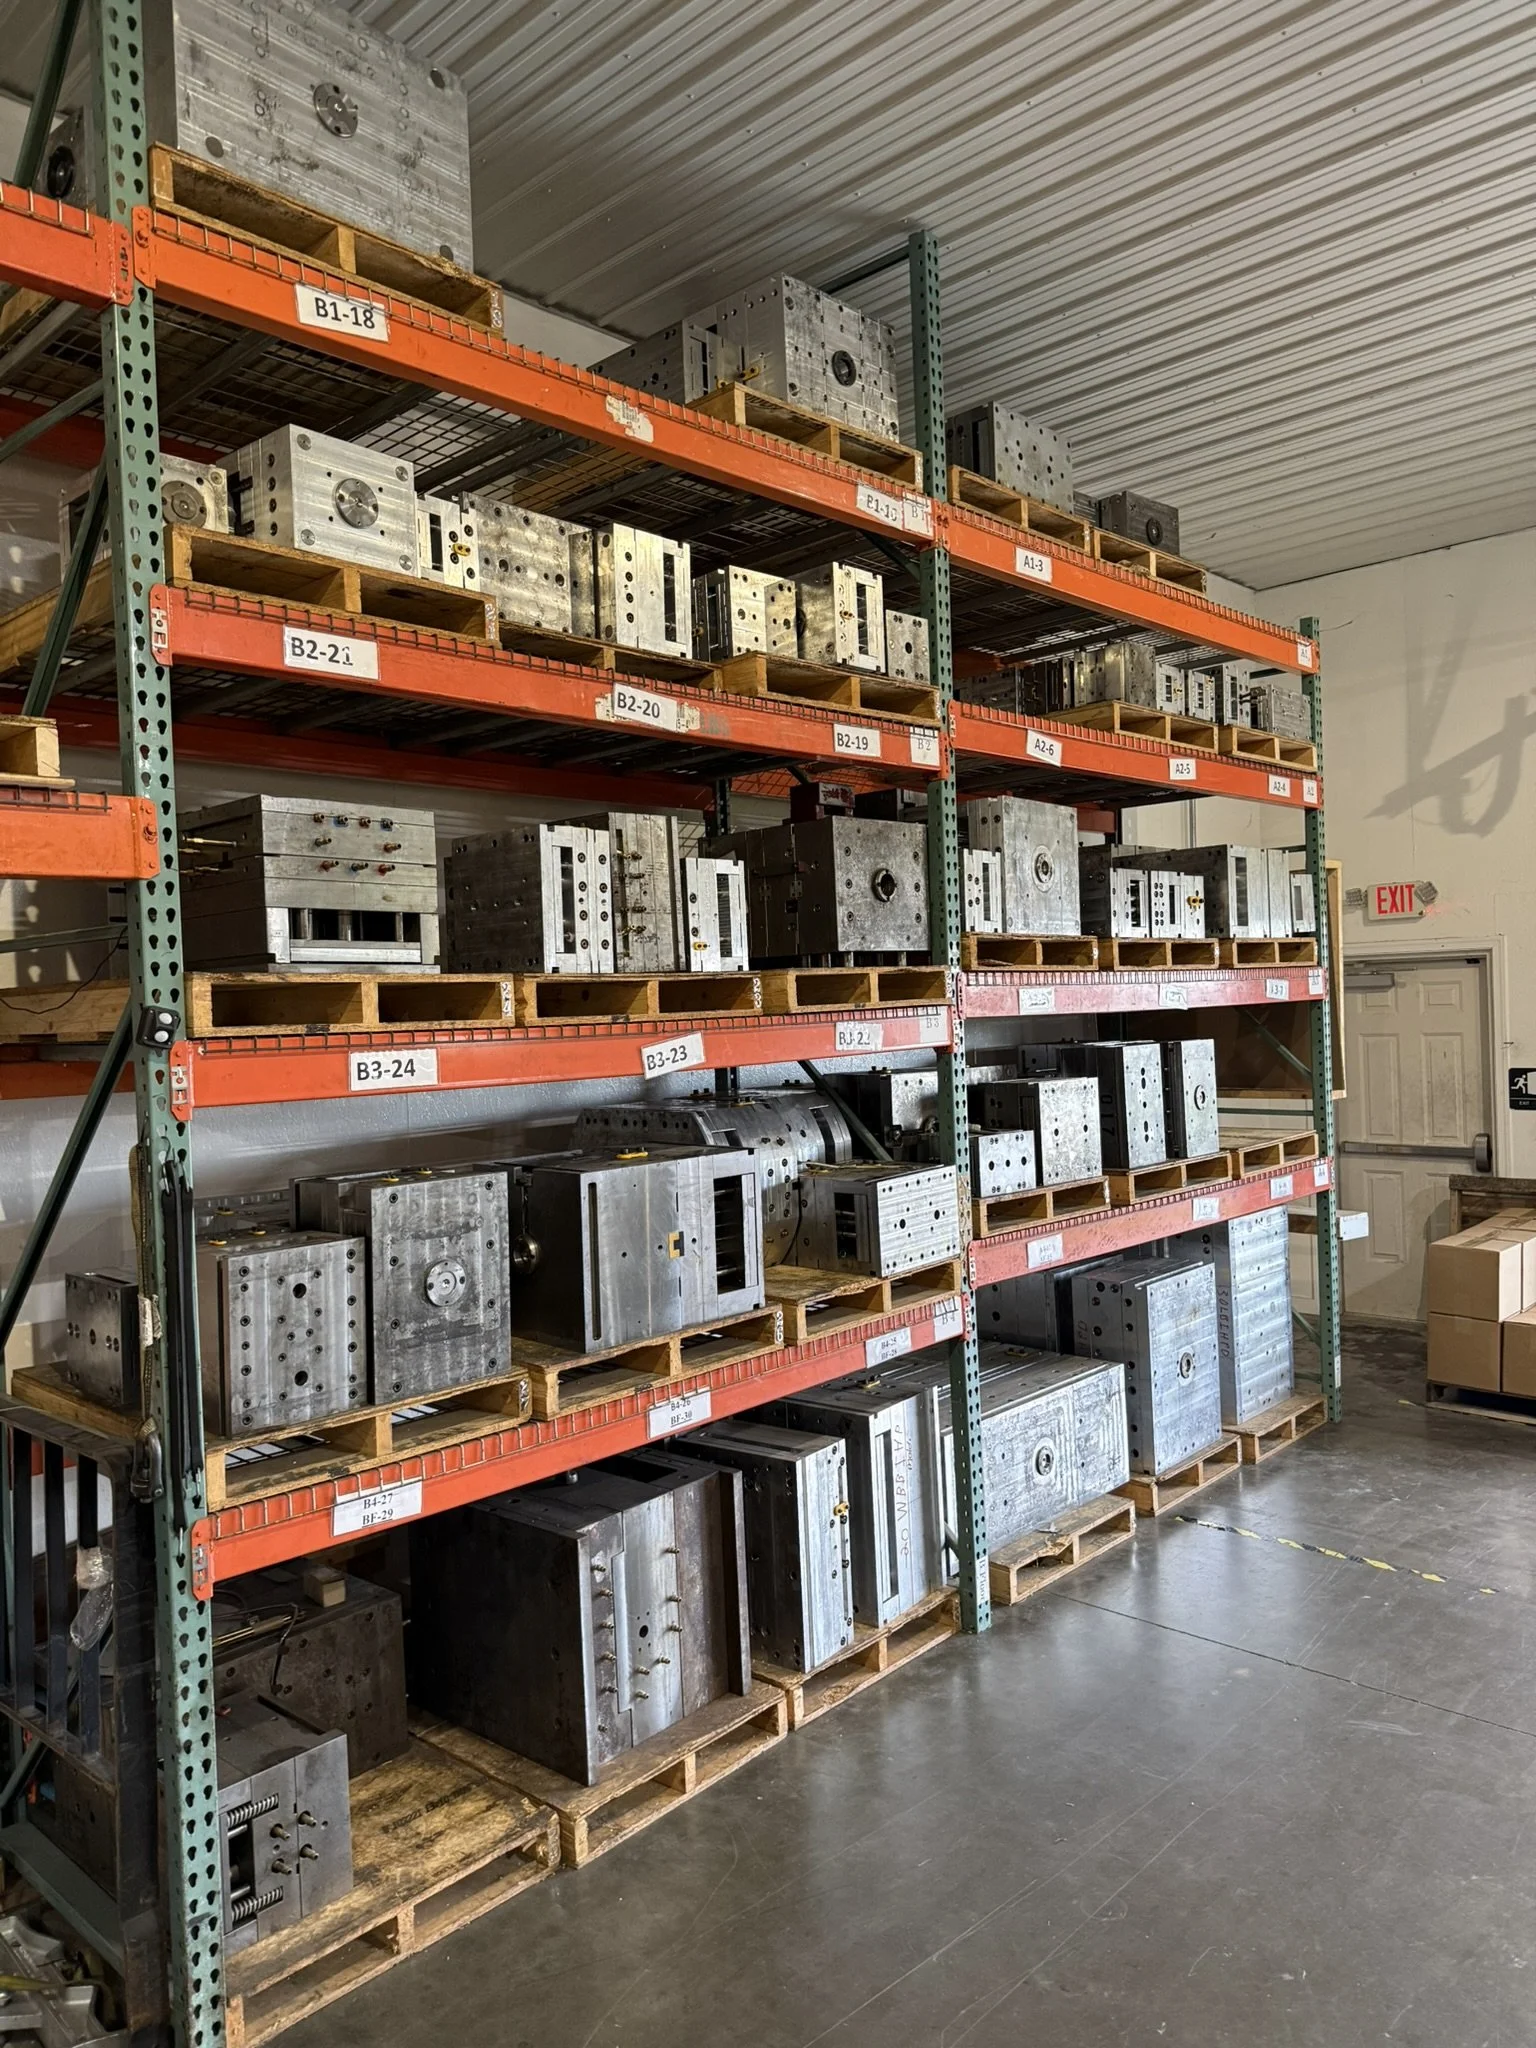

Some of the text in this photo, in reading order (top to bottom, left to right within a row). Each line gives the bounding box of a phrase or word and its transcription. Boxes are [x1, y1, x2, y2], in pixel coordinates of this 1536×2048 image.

[314, 297, 375, 330] B1-18
[1023, 555, 1043, 572] A1-3
[290, 636, 354, 666] B2-21
[617, 692, 661, 719] B2-20
[836, 732, 869, 751] B2-19
[1034, 738, 1055, 756] A2-6
[1175, 763, 1191, 775] A2-5
[1272, 780, 1286, 792] A2-4
[1375, 884, 1415, 915] EXIT
[646, 1045, 688, 1071] B3-23
[356, 1058, 416, 1081] B3-24
[363, 1493, 394, 1510] B4-27
[362, 1509, 394, 1526] BF-29
